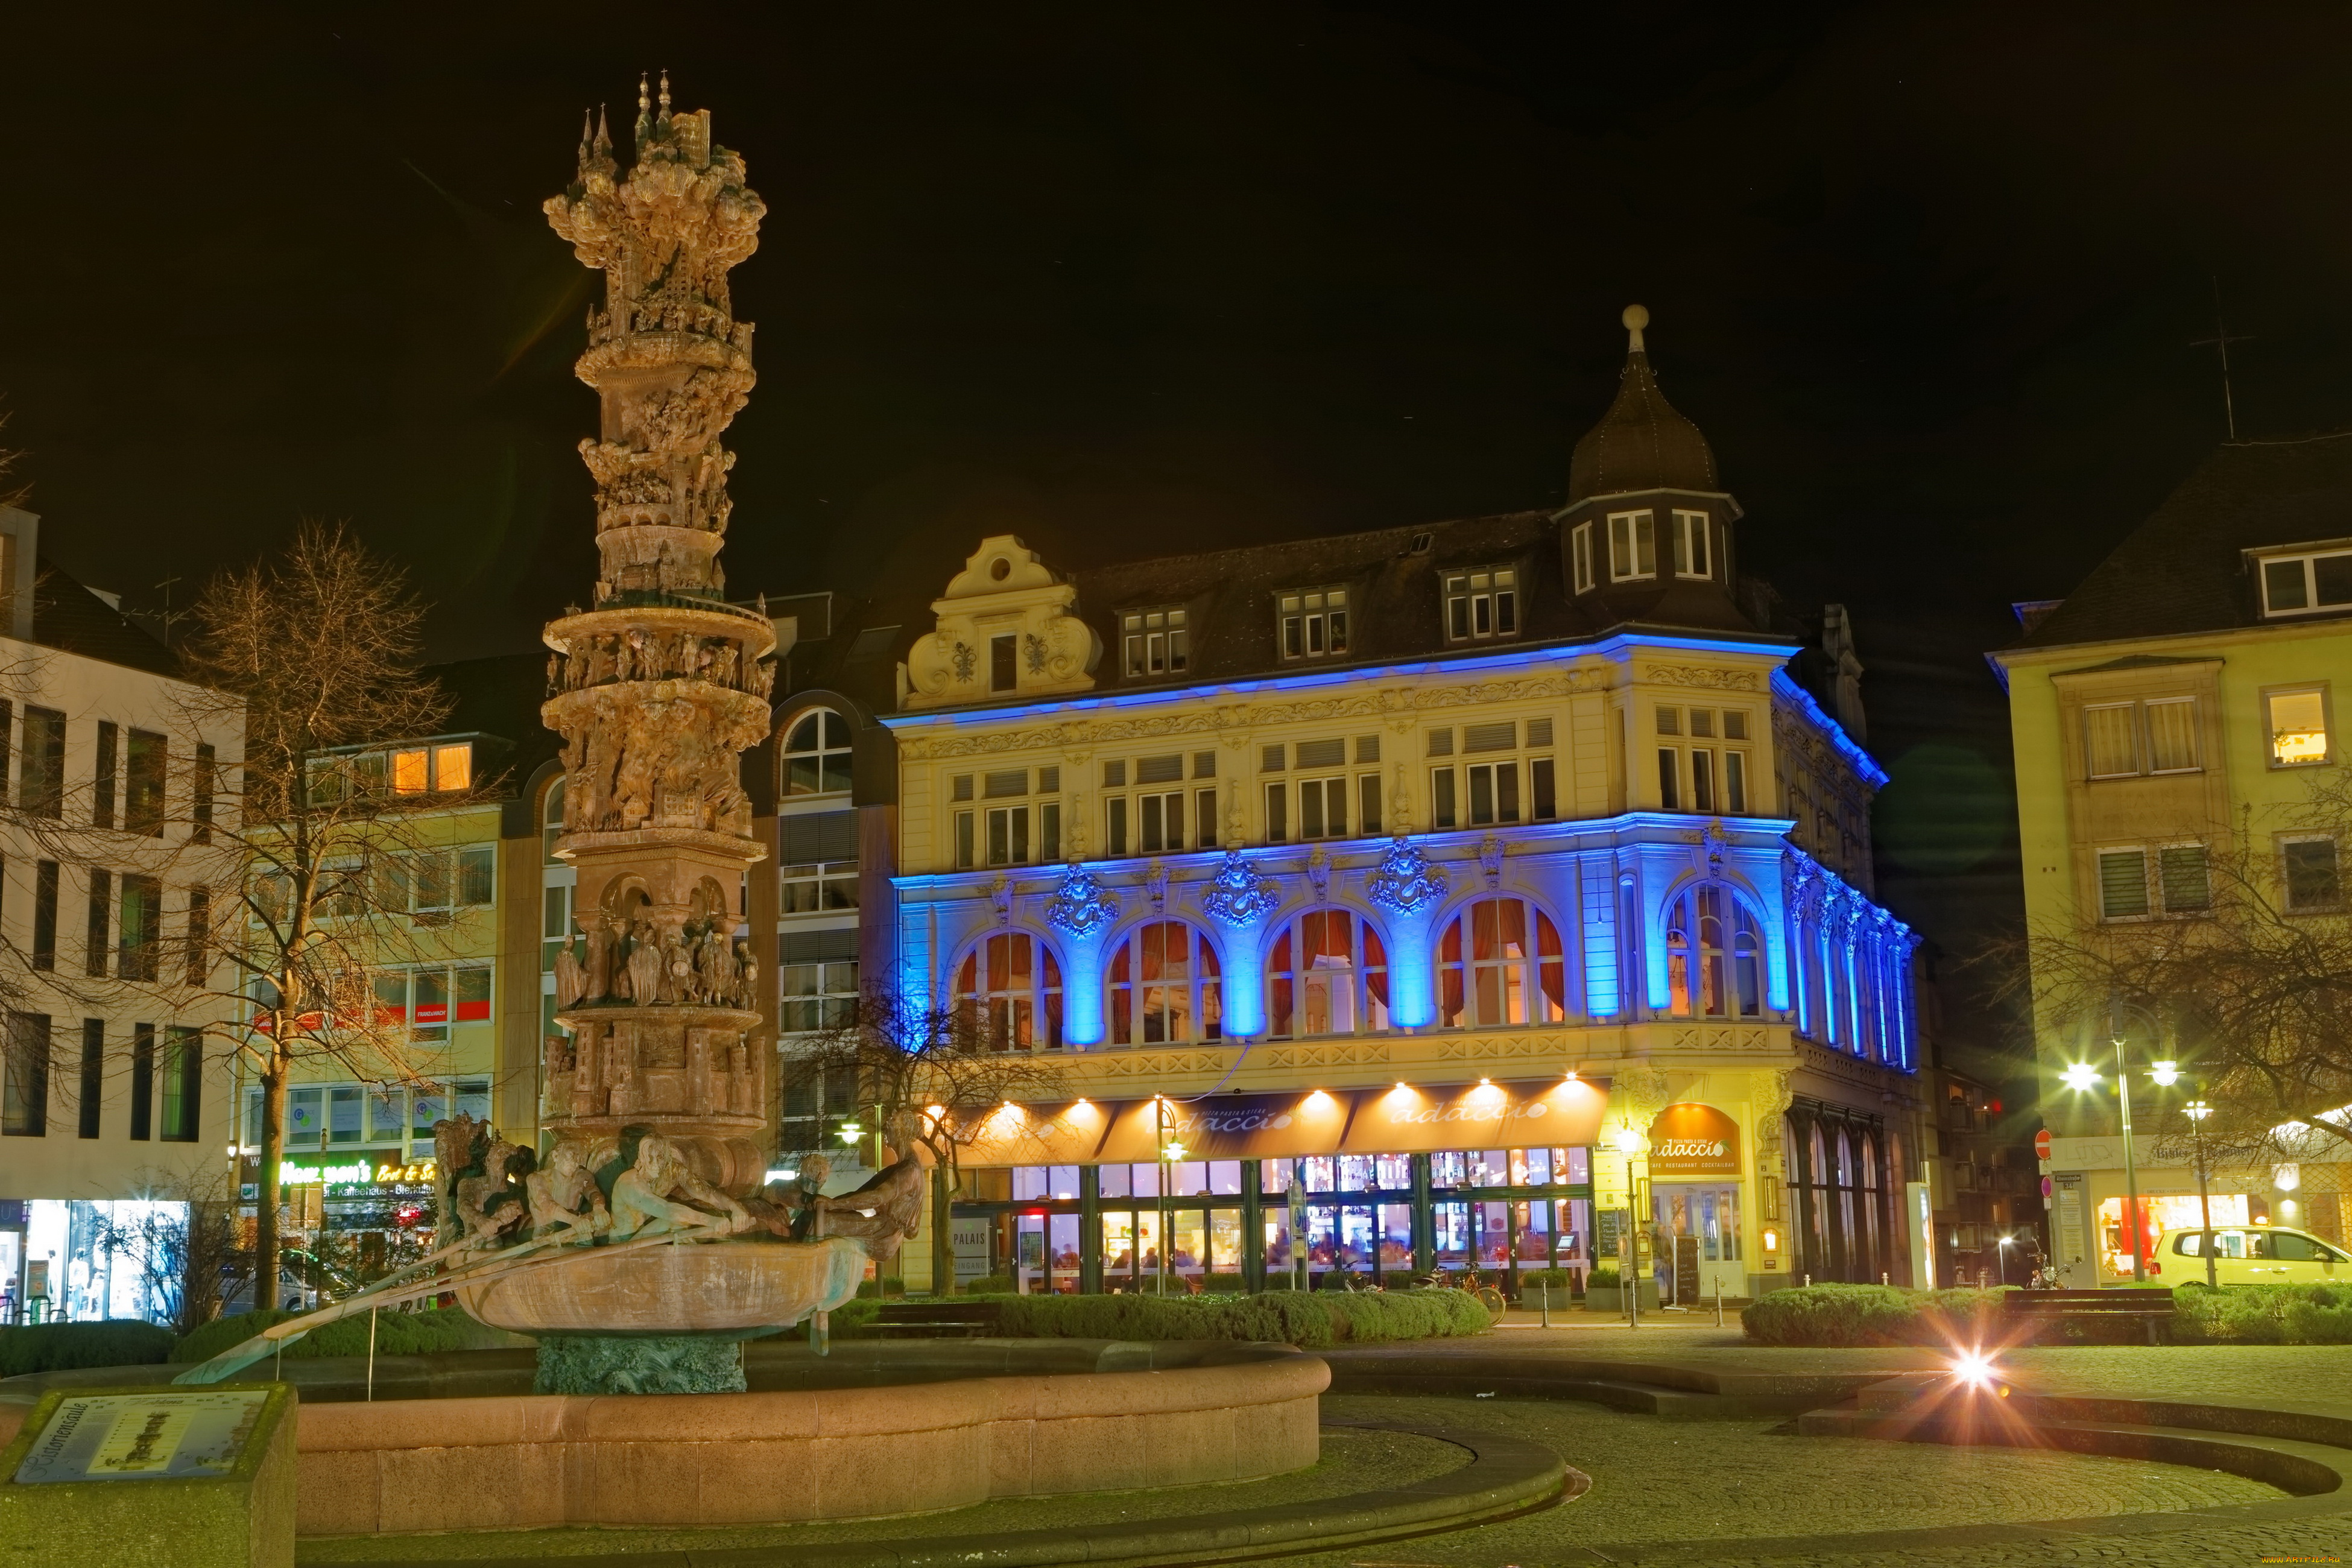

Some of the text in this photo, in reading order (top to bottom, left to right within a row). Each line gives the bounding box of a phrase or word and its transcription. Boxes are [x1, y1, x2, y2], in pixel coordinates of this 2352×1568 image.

[1390, 1100, 1548, 1124] adaccio
[1649, 1139, 1724, 1157] adaccio
[2155, 1146, 2189, 1159] Bilder
[376, 1165, 402, 1181] Brot
[405, 1165, 418, 1181] &
[338, 1186, 387, 1197] Kaffeehaus
[395, 1184, 434, 1195] Bierkultu
[953, 1233, 985, 1245] PALAIS
[24, 1403, 89, 1478] Historiensäule
